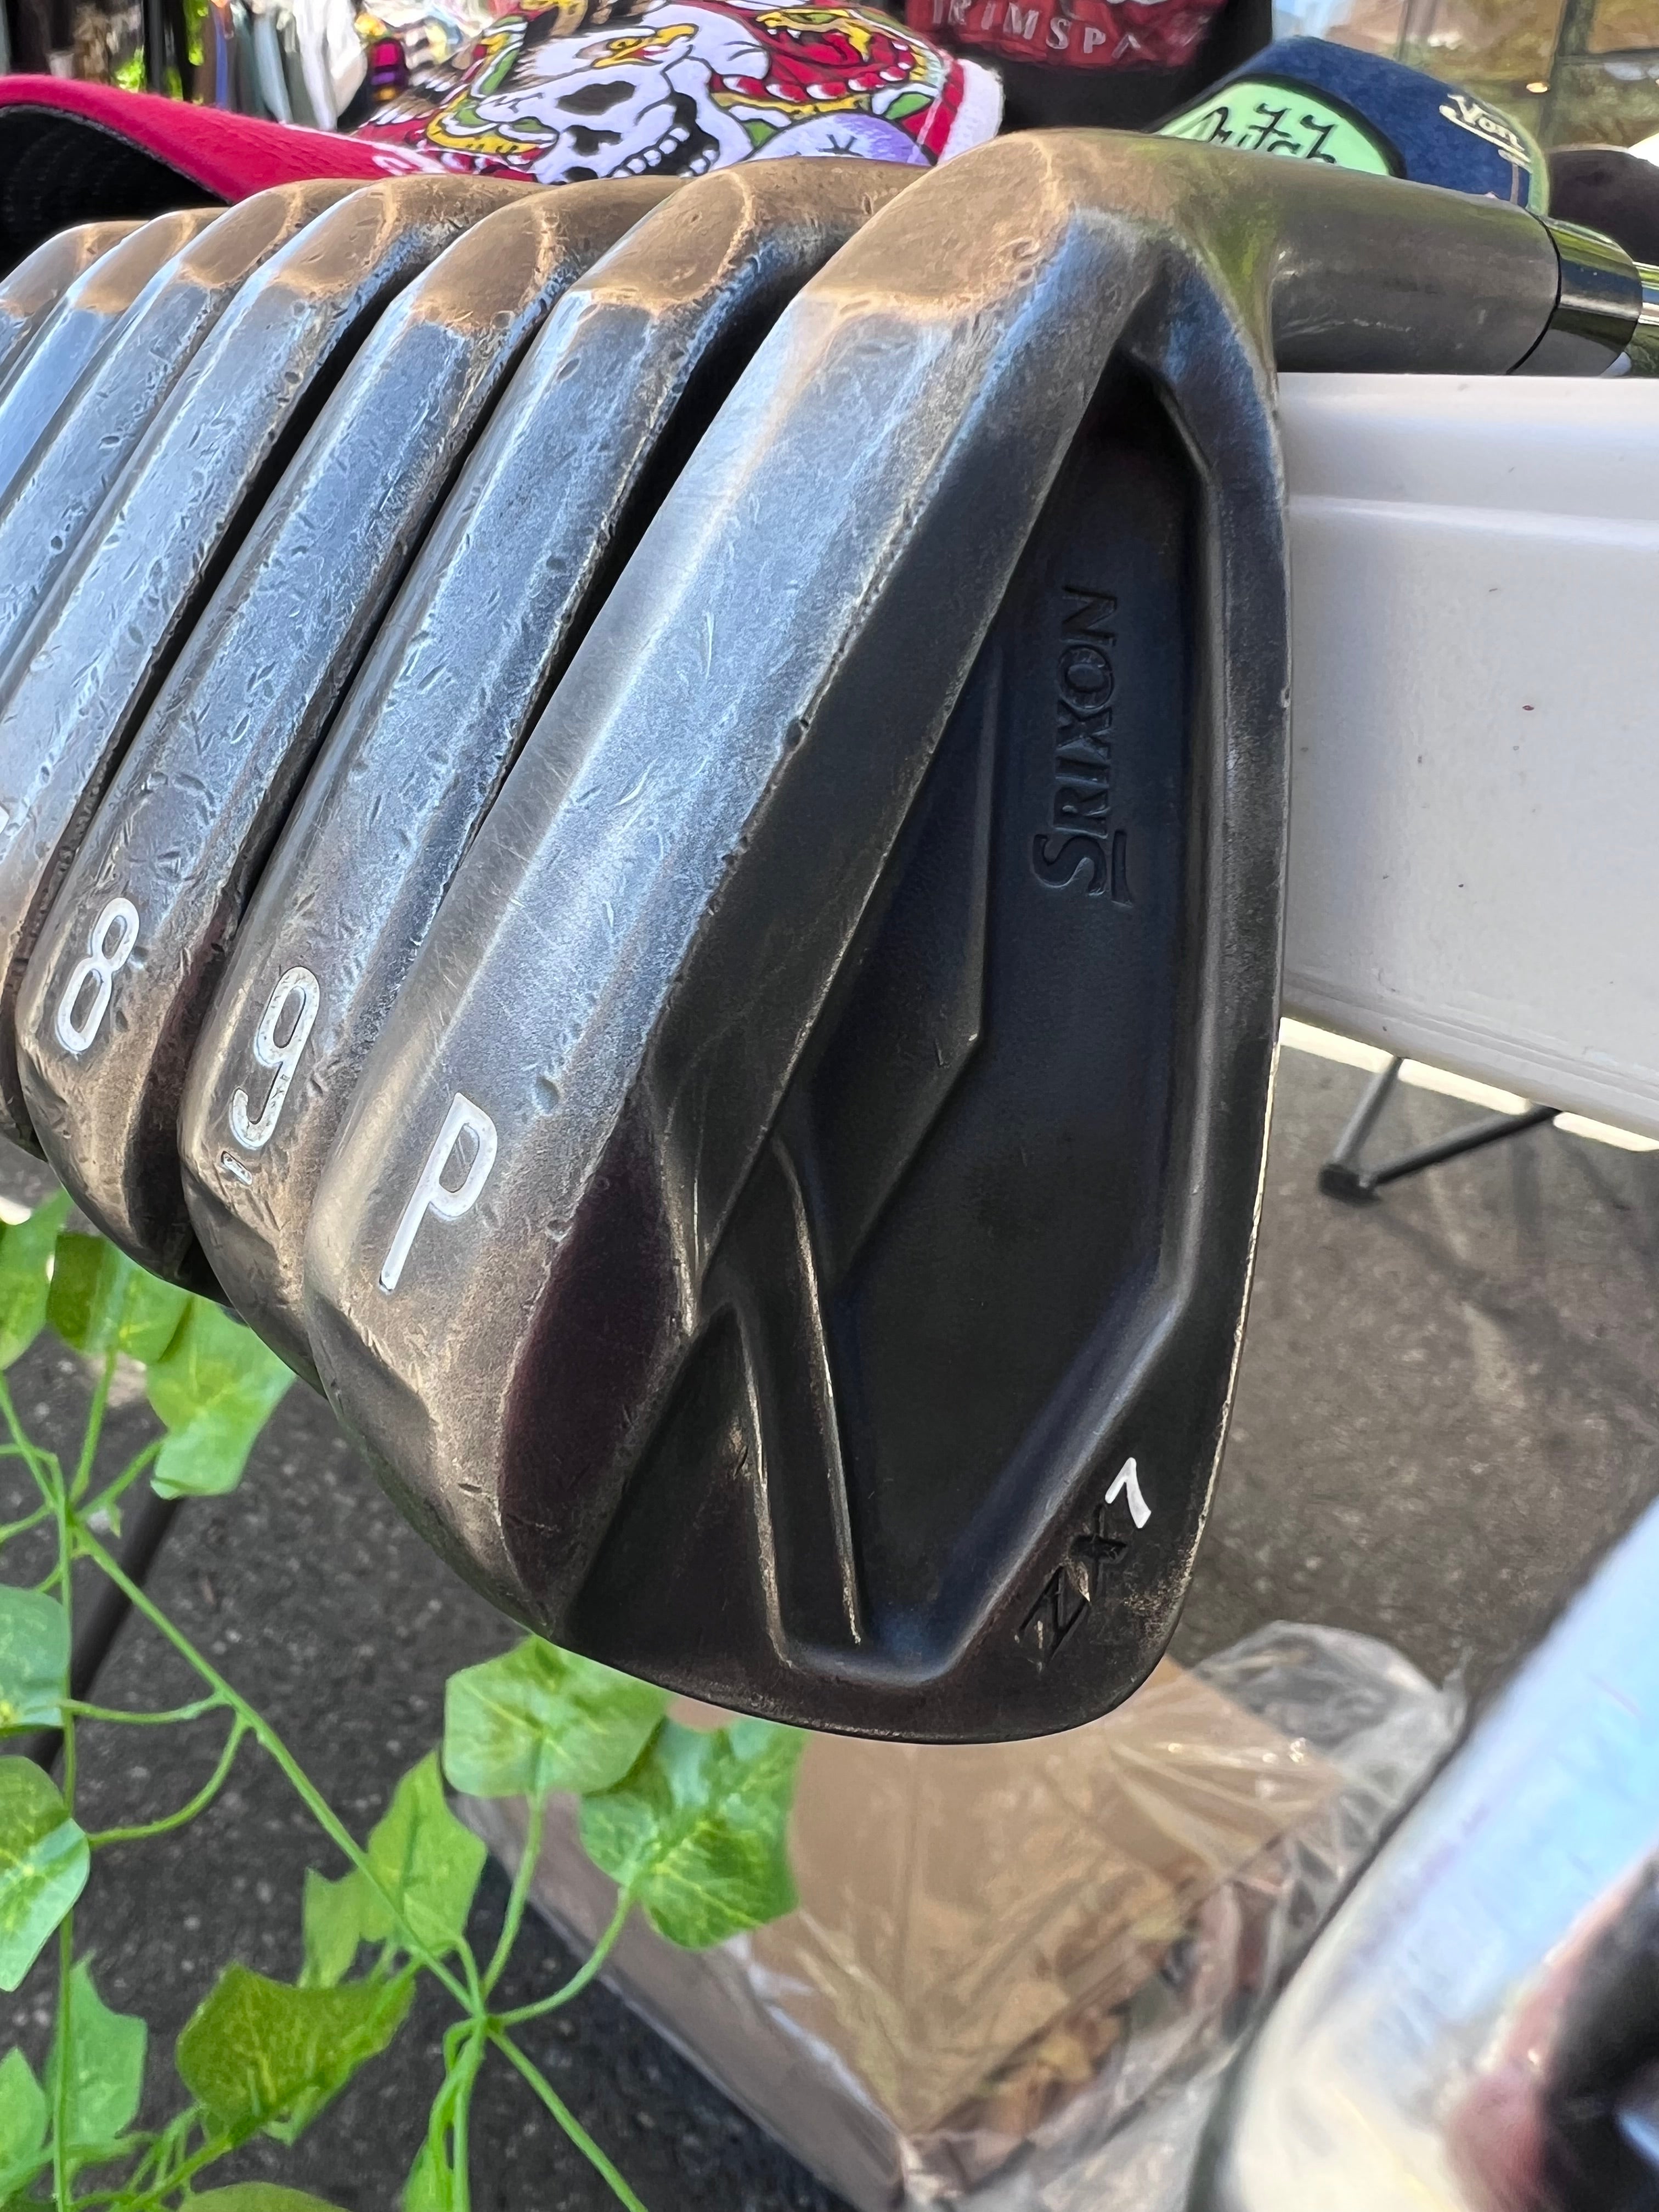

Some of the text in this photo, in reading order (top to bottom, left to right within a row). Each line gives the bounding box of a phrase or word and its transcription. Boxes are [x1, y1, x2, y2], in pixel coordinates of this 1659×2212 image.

[1031, 585, 1133, 908] SRIXON
[58, 897, 140, 1054] 8
[228, 966, 320, 1149] 9
[380, 1092, 498, 1293] P
